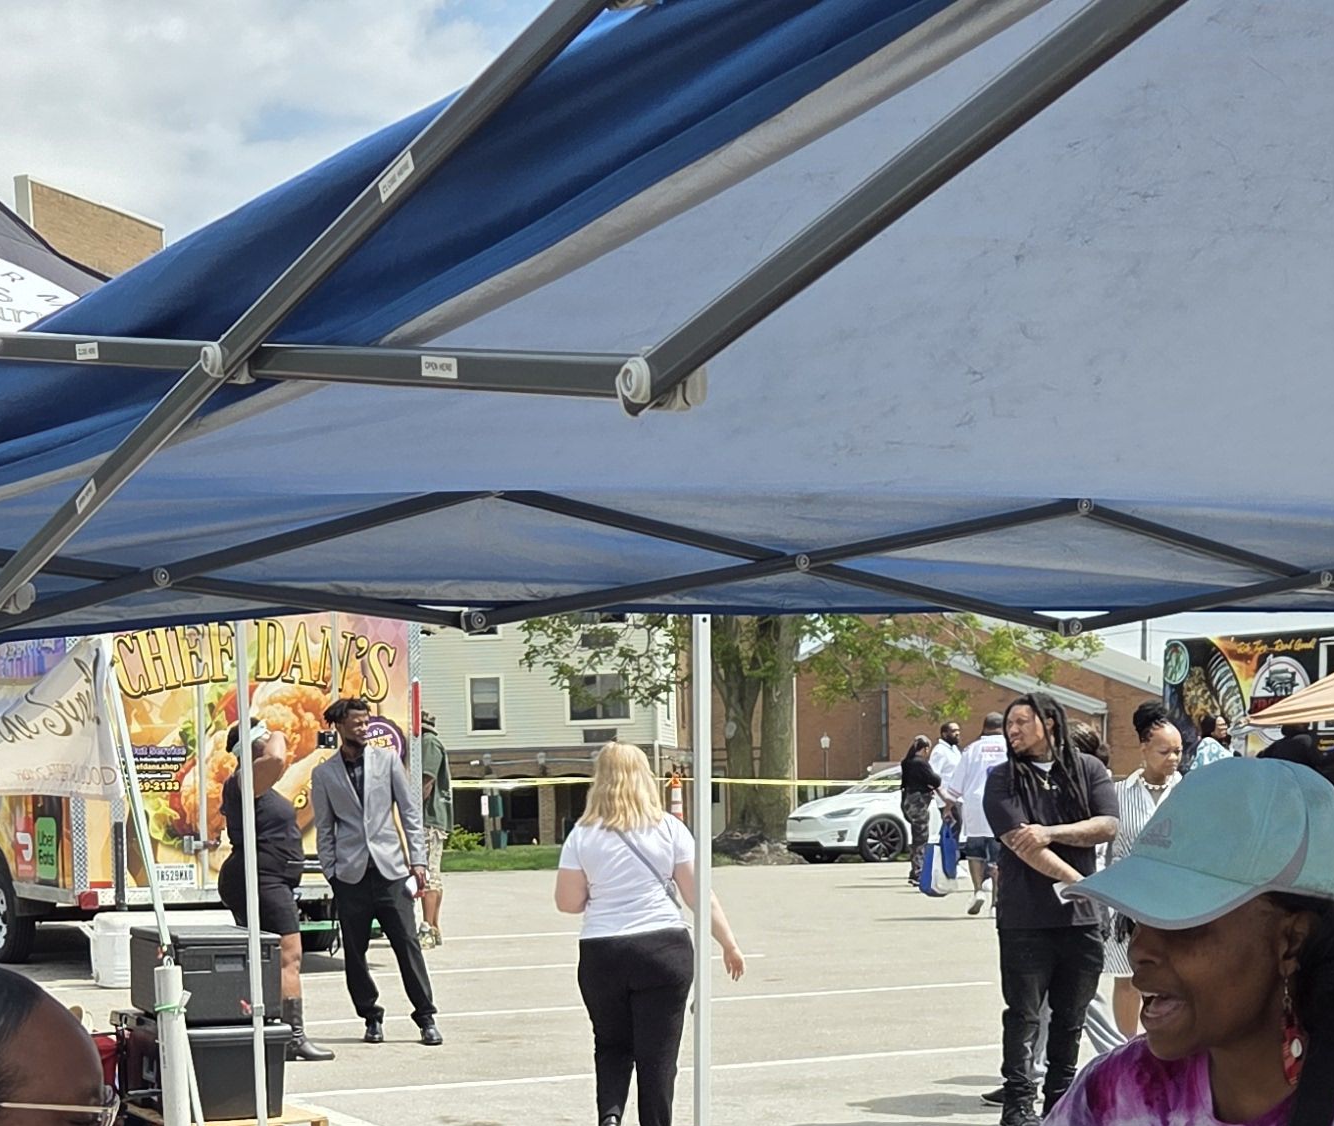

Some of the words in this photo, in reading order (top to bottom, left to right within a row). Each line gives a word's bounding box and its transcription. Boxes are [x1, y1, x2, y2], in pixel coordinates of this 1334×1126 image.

[113, 620, 236, 699] CHEF
[254, 619, 397, 702] DAN'S
[38, 829, 54, 847] Uber
[38, 849, 54, 866] Eats
